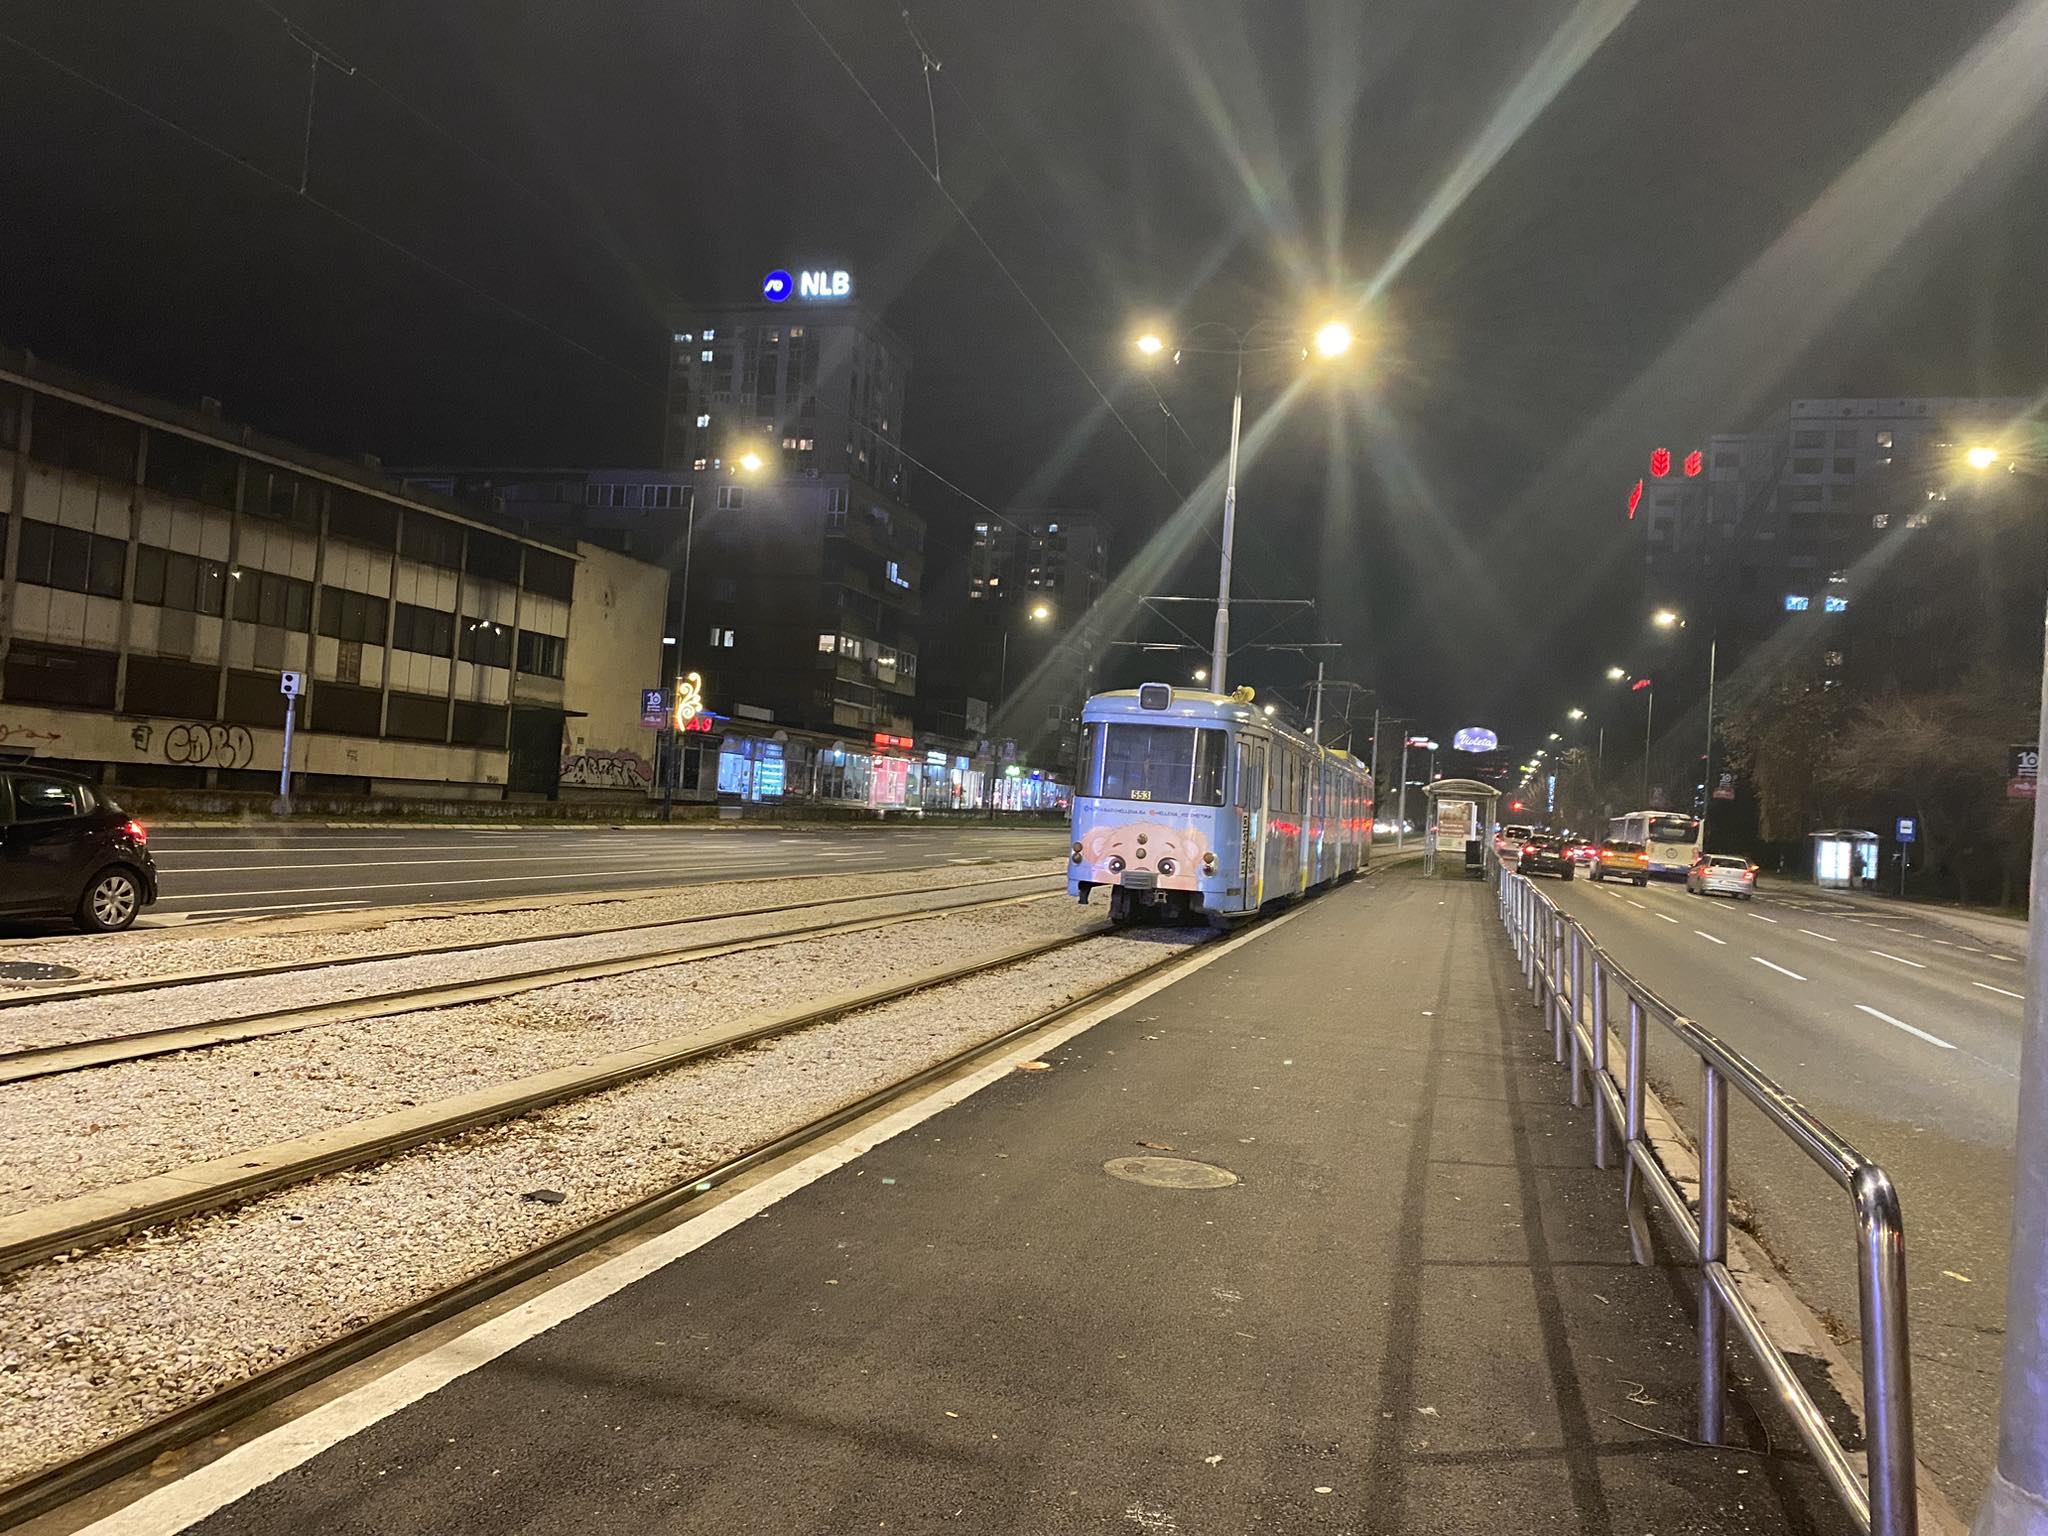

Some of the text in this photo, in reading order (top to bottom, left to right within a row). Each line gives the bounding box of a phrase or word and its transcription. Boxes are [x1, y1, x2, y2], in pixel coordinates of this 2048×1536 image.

[800, 270, 850, 296] NLB
[1459, 734, 1493, 747] Violeta
[1132, 790, 1150, 799] 553
